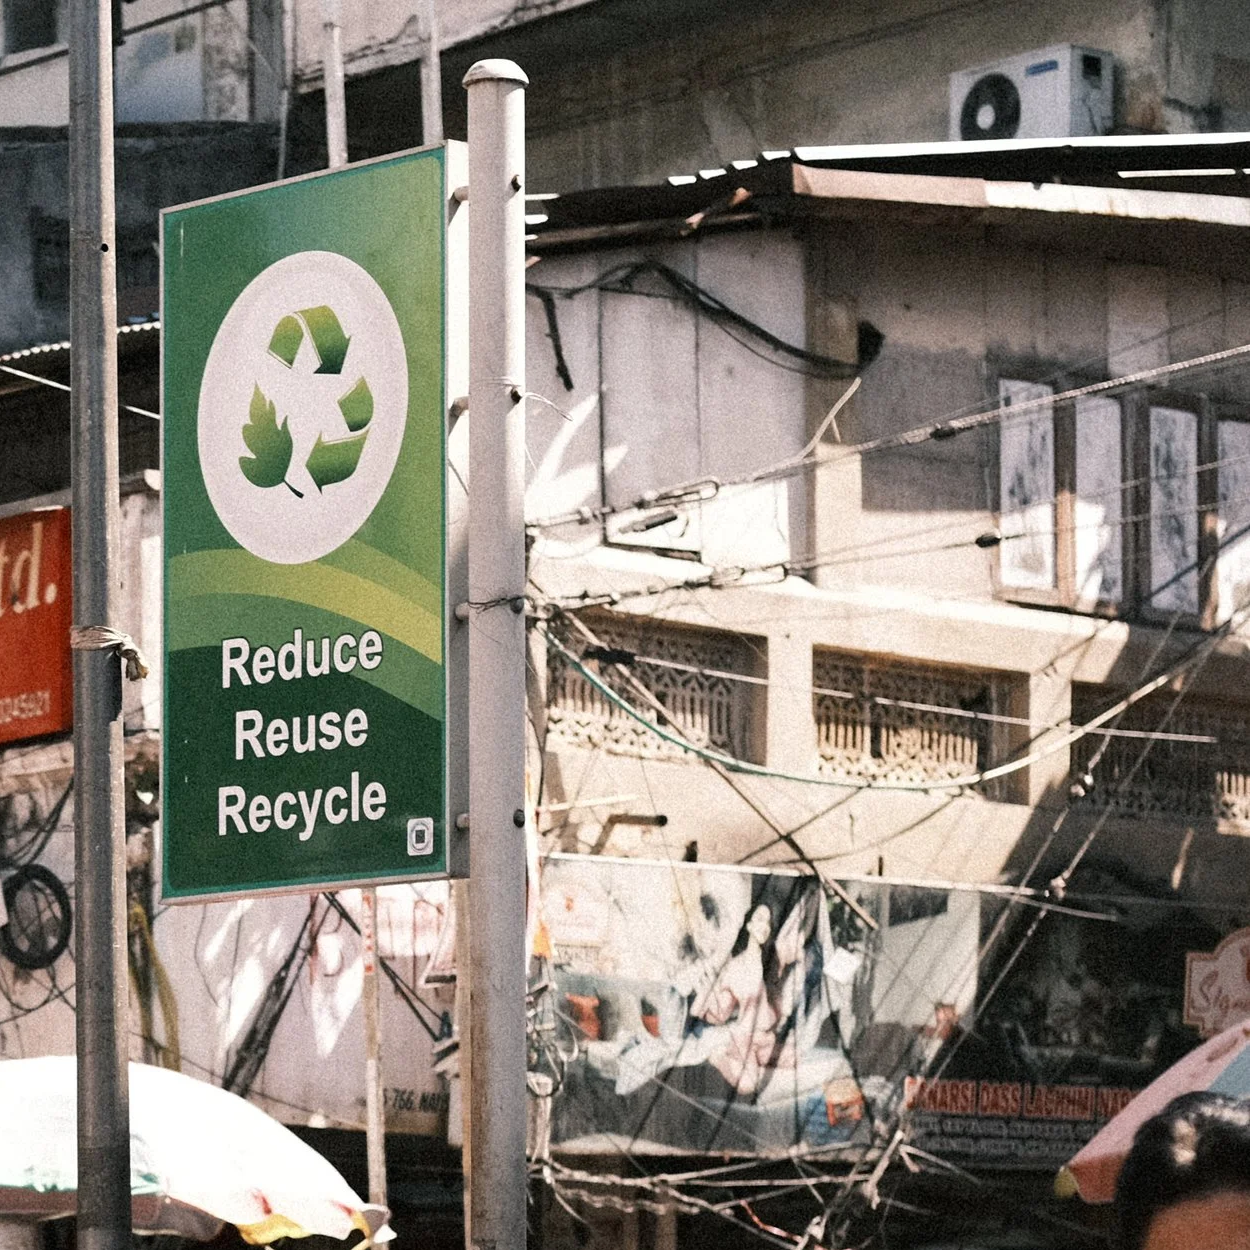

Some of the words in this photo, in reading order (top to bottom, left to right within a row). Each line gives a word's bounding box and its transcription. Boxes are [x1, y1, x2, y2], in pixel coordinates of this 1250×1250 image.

[222, 628, 383, 689] Reduce
[235, 707, 369, 760] Reuse
[218, 771, 387, 842] Recycle
